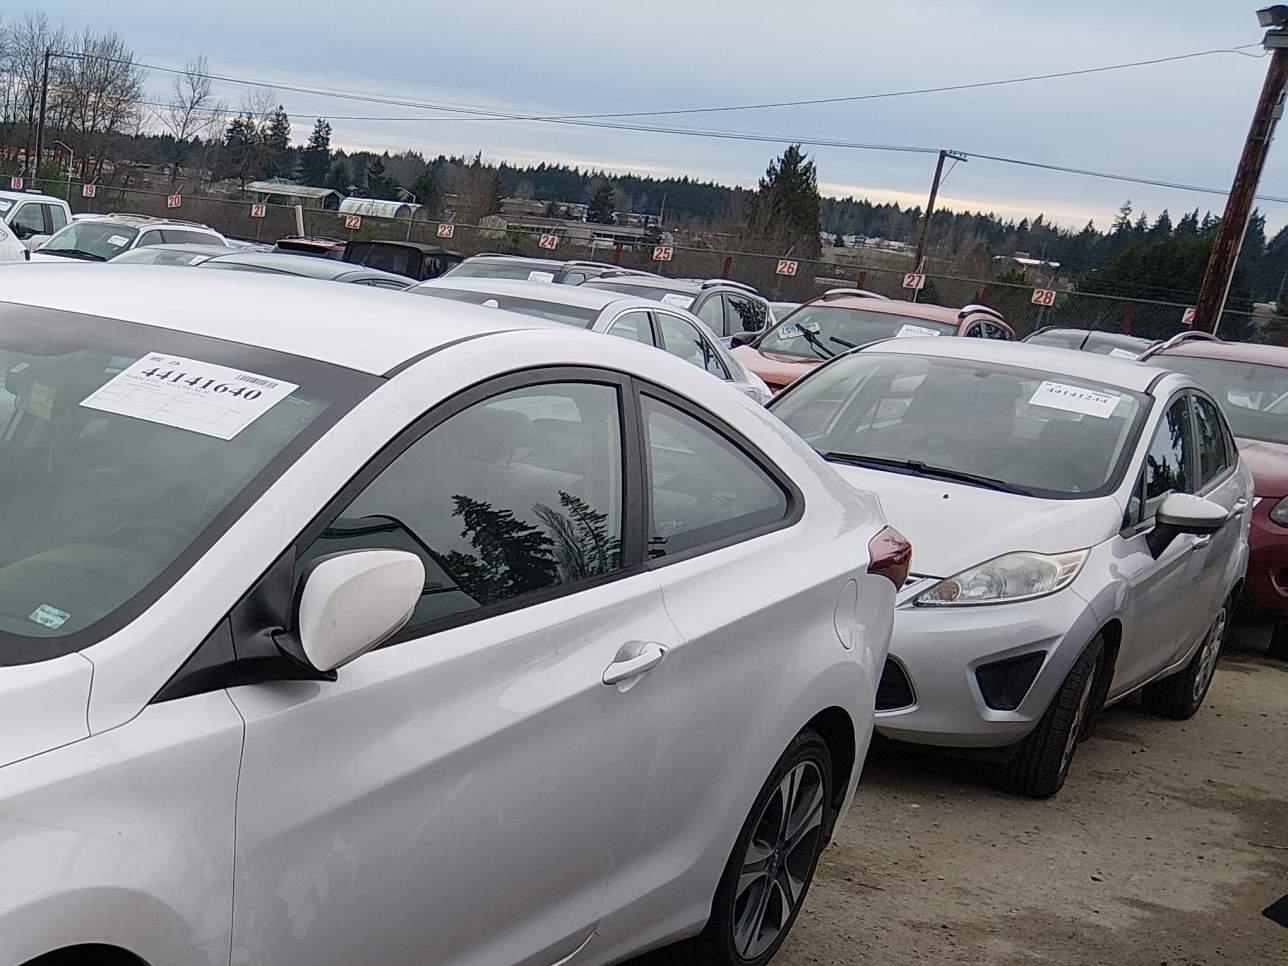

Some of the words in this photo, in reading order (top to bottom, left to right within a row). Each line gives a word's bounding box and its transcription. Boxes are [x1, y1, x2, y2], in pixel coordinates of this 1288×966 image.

[168, 195, 180, 207] 20
[346, 216, 360, 228] 22
[438, 224, 453, 237] 23
[540, 234, 556, 248] 24
[655, 247, 671, 260] 25
[778, 261, 795, 274] 26
[905, 274, 922, 288] 27
[1033, 290, 1053, 306] 28
[140, 367, 263, 401] 44141640
